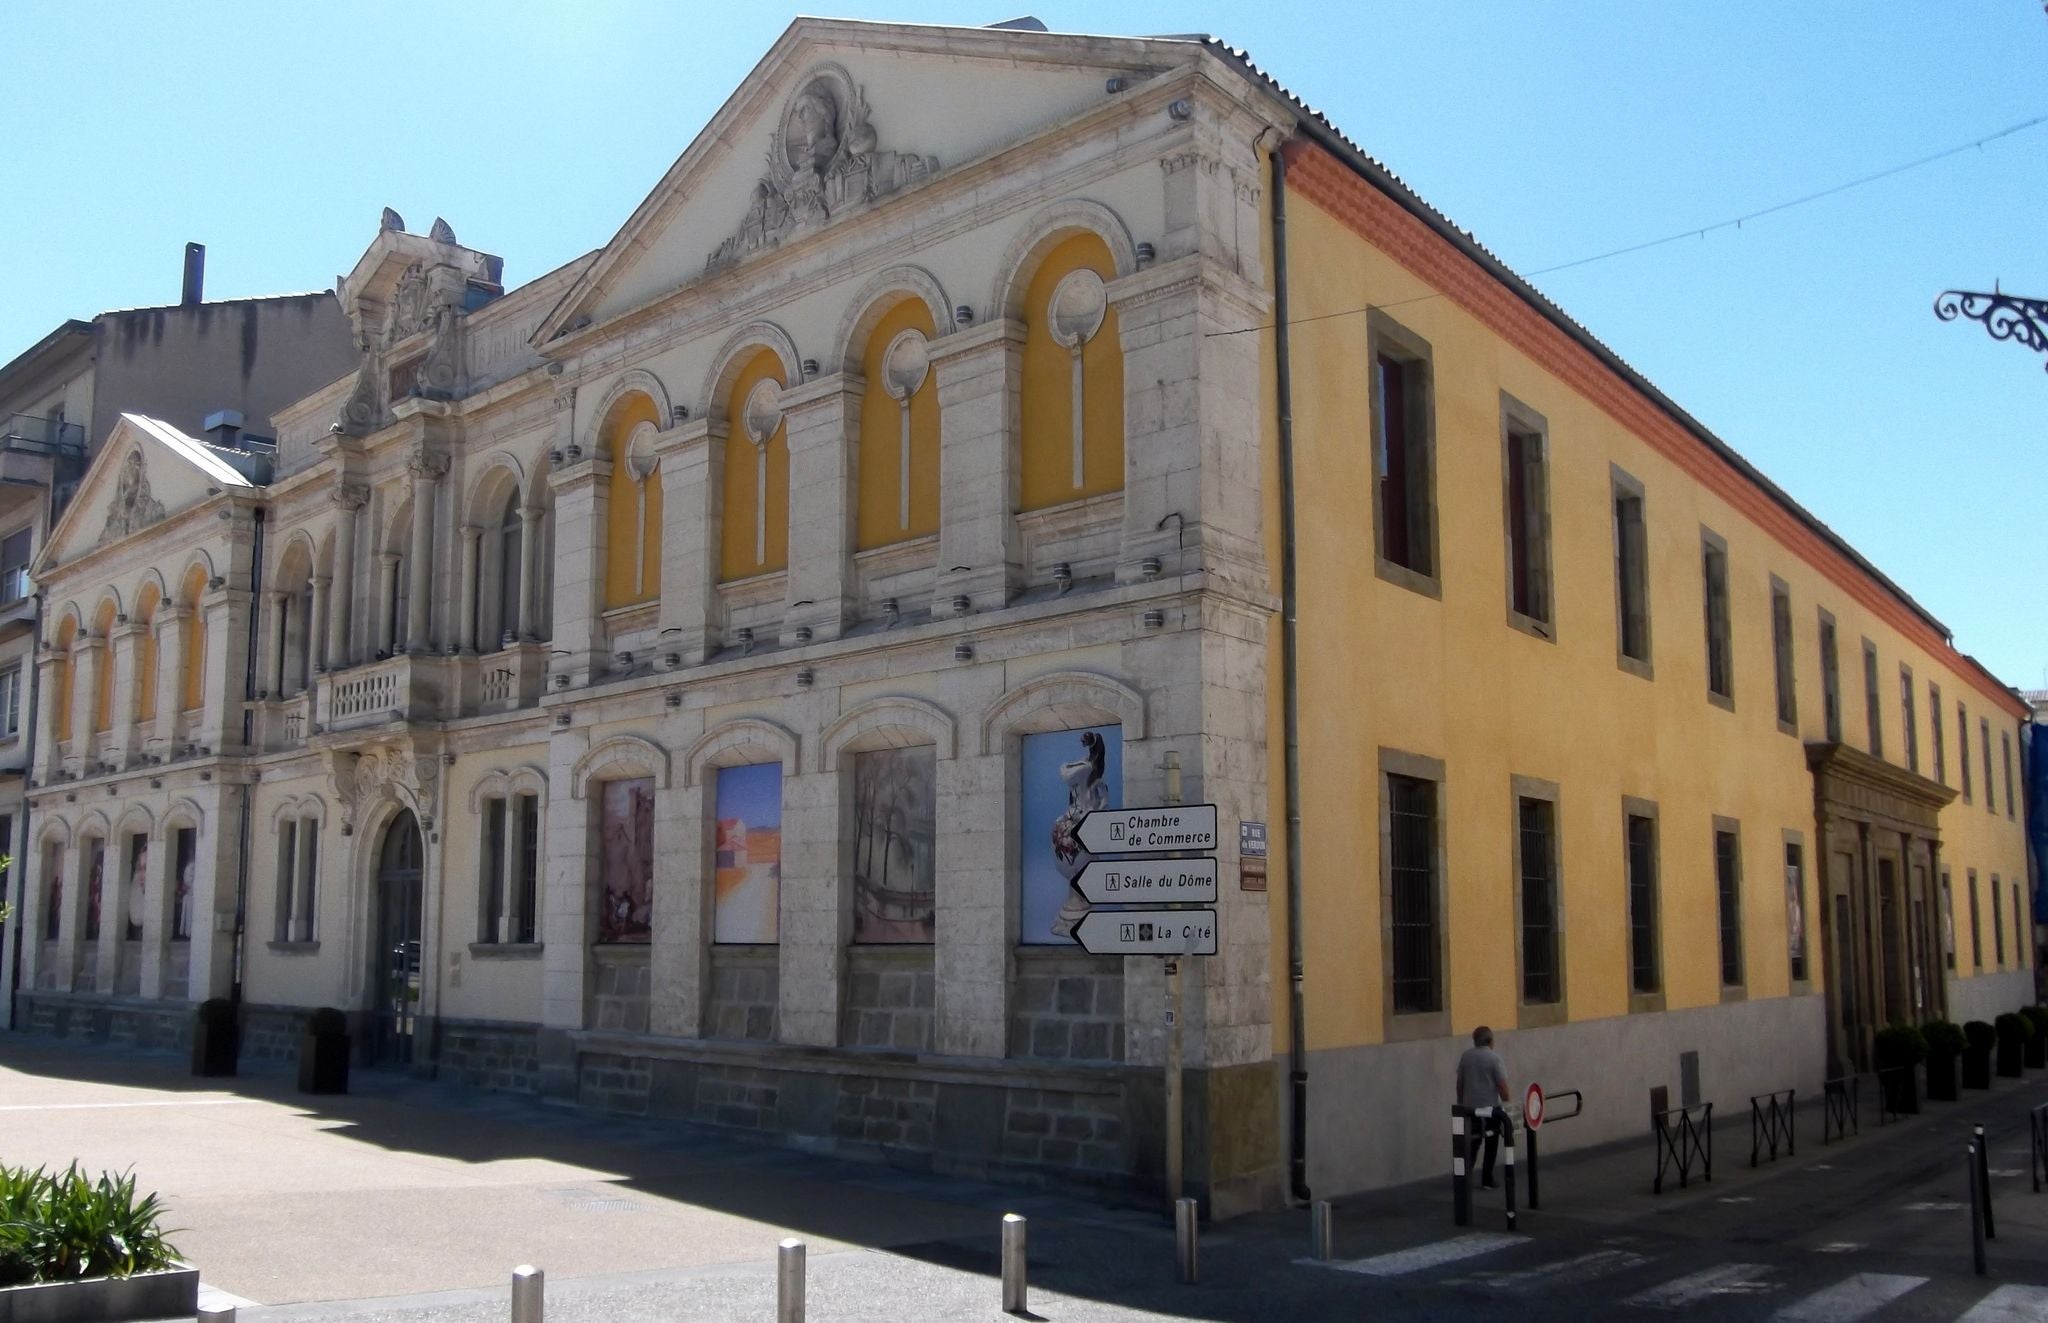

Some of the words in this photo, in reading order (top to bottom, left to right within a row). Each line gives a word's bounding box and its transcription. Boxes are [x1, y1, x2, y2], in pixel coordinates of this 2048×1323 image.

[1128, 814, 1180, 830] Chambre
[1128, 833, 1142, 847] de
[1148, 832, 1211, 846] Commerce
[1123, 873, 1153, 889] Salle
[1158, 873, 1173, 888] du
[1178, 873, 1212, 887] Dôme
[1158, 925, 1171, 939] La
